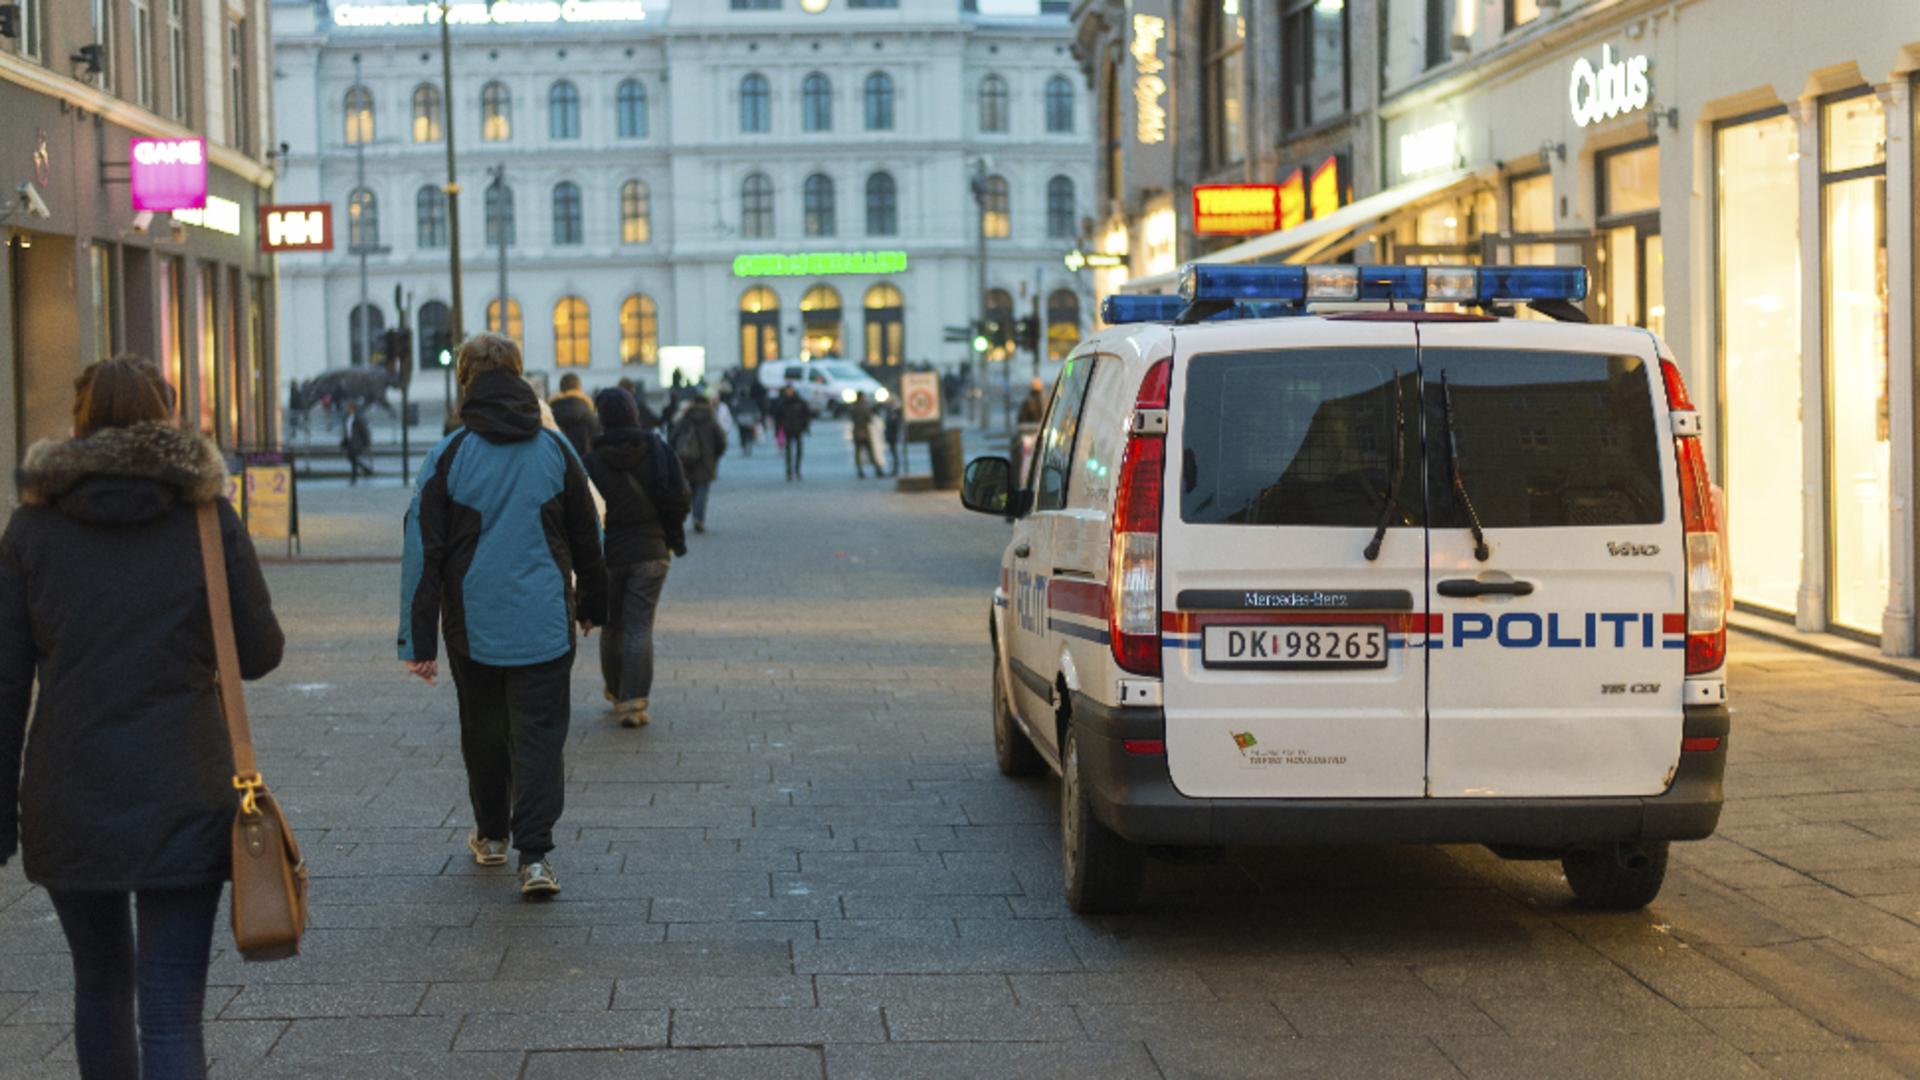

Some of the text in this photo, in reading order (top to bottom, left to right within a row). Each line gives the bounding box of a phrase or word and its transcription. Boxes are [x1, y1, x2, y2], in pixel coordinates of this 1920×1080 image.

[1570, 43, 1648, 127] Cubus
[134, 140, 202, 165] GAME
[1606, 541, 1661, 557] Vito
[1245, 592, 1348, 607] Mercedes-Benz
[1452, 612, 1654, 648] POLITI
